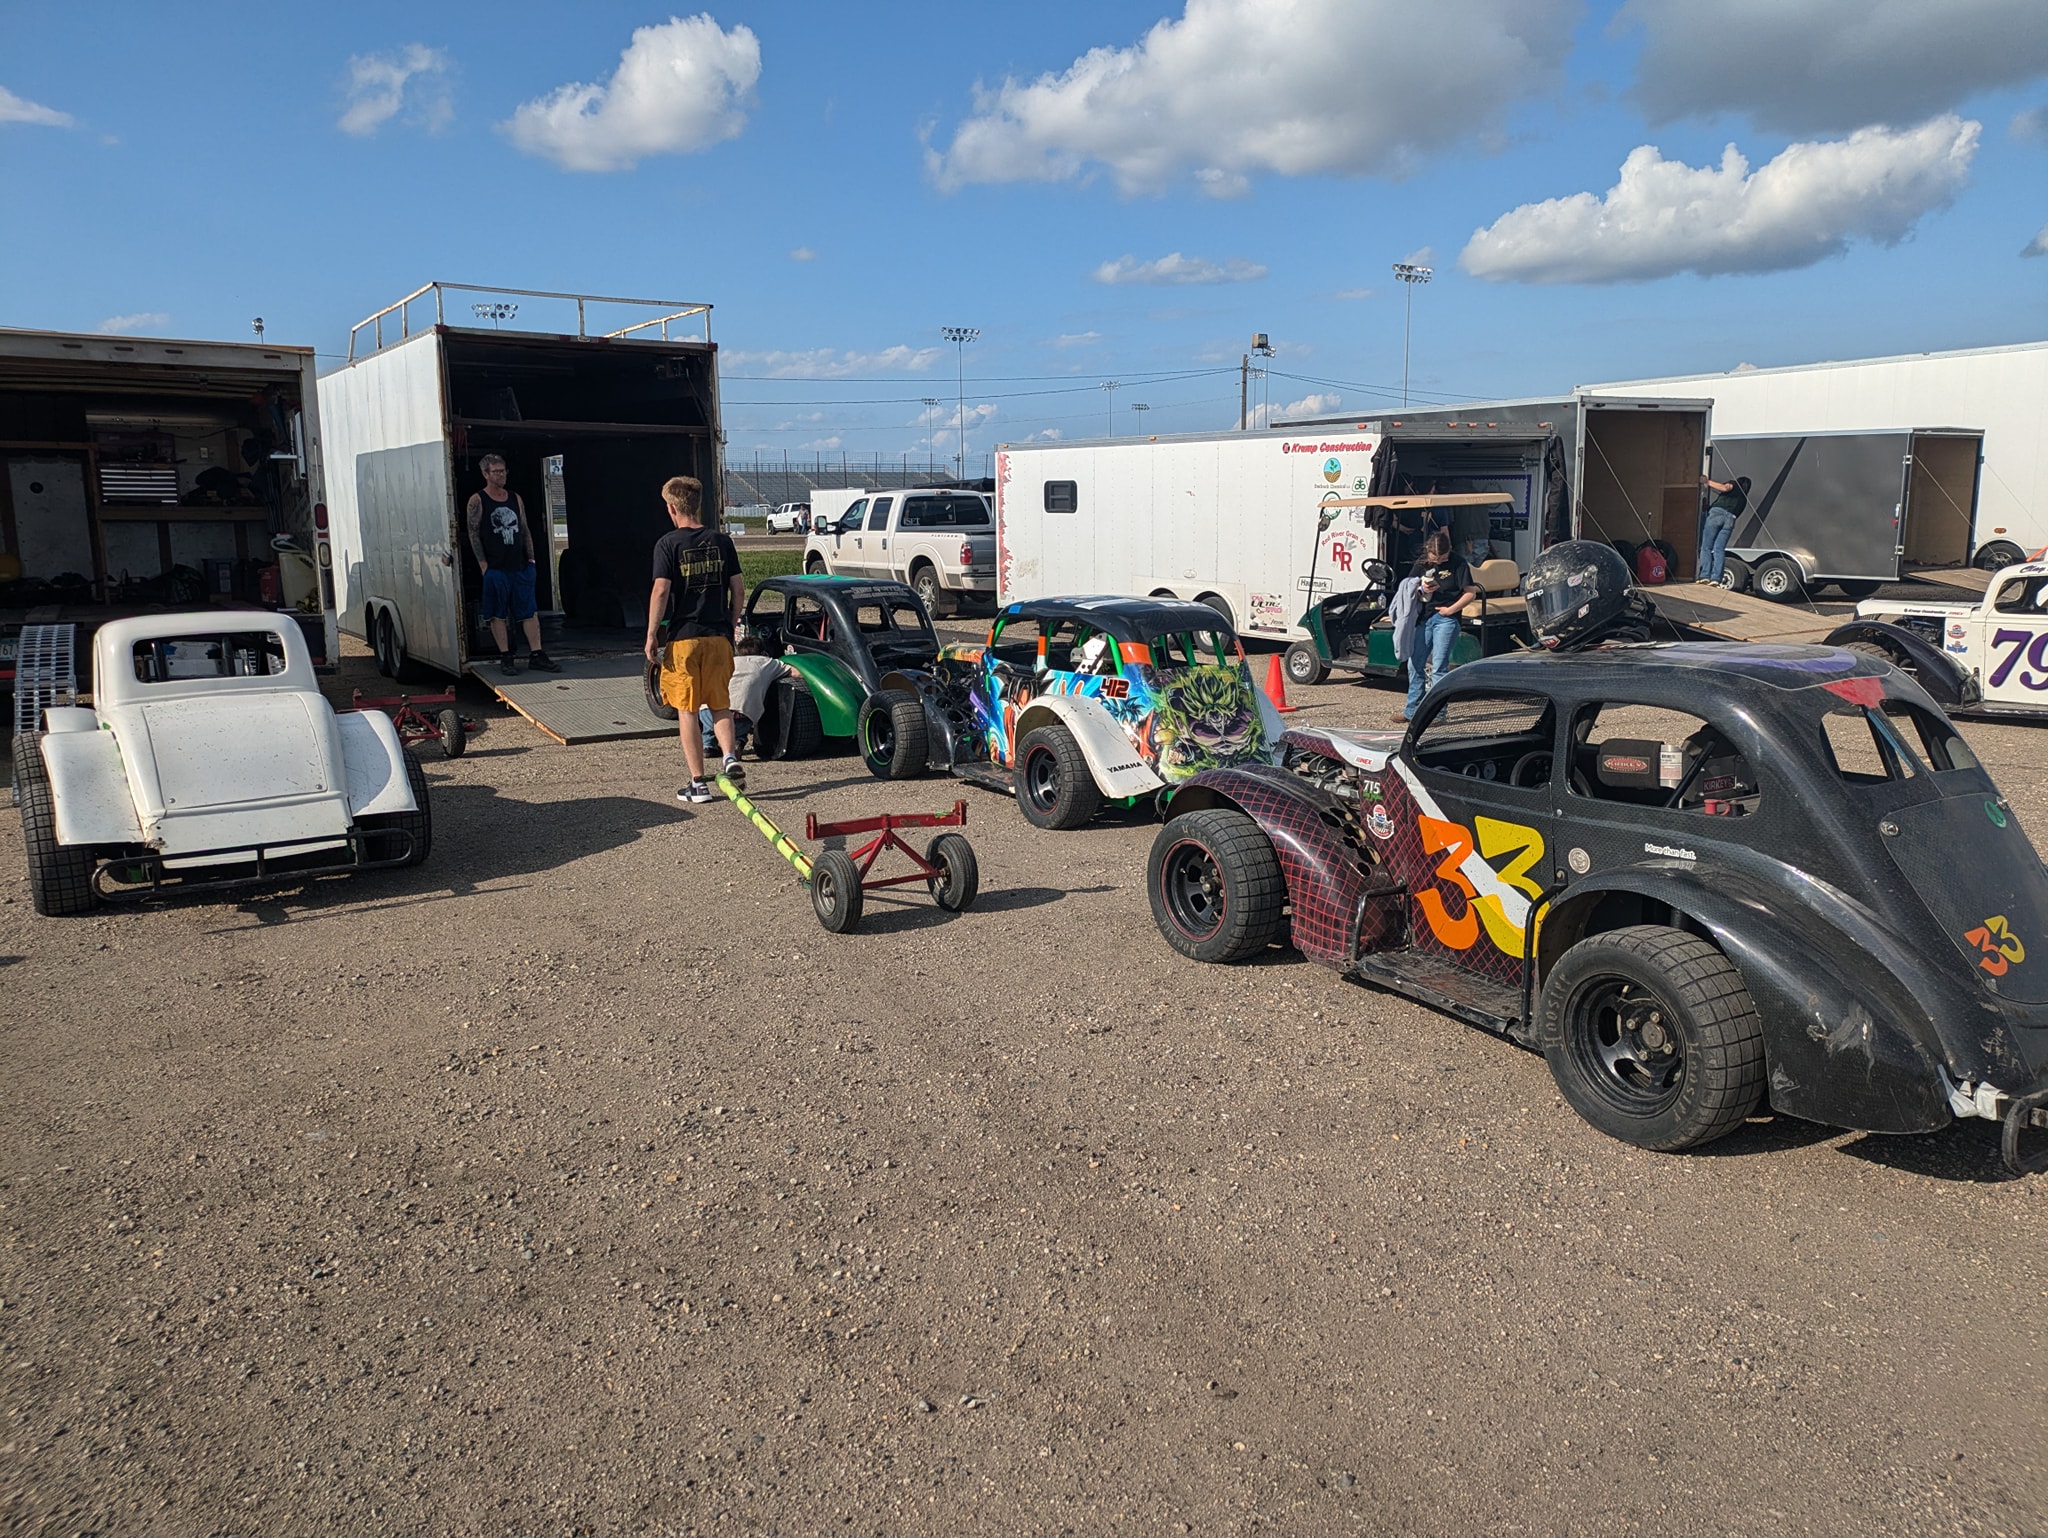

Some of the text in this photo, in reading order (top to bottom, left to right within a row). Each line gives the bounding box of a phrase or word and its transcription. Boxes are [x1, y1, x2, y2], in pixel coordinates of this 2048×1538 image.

[1320, 441, 1373, 453] Construction
[1321, 535, 1332, 547] Red
[1331, 530, 1345, 538] River
[1346, 530, 1359, 541] Grain
[1300, 579, 1328, 588] Hamark
[1100, 677, 1130, 700] 412
[1106, 761, 1143, 774] YAMAHA
[1363, 780, 1381, 794] 715
[1645, 843, 1663, 855] More
[1663, 845, 1680, 858] than
[1415, 814, 1550, 960] 33
[1963, 914, 2025, 977] 33
